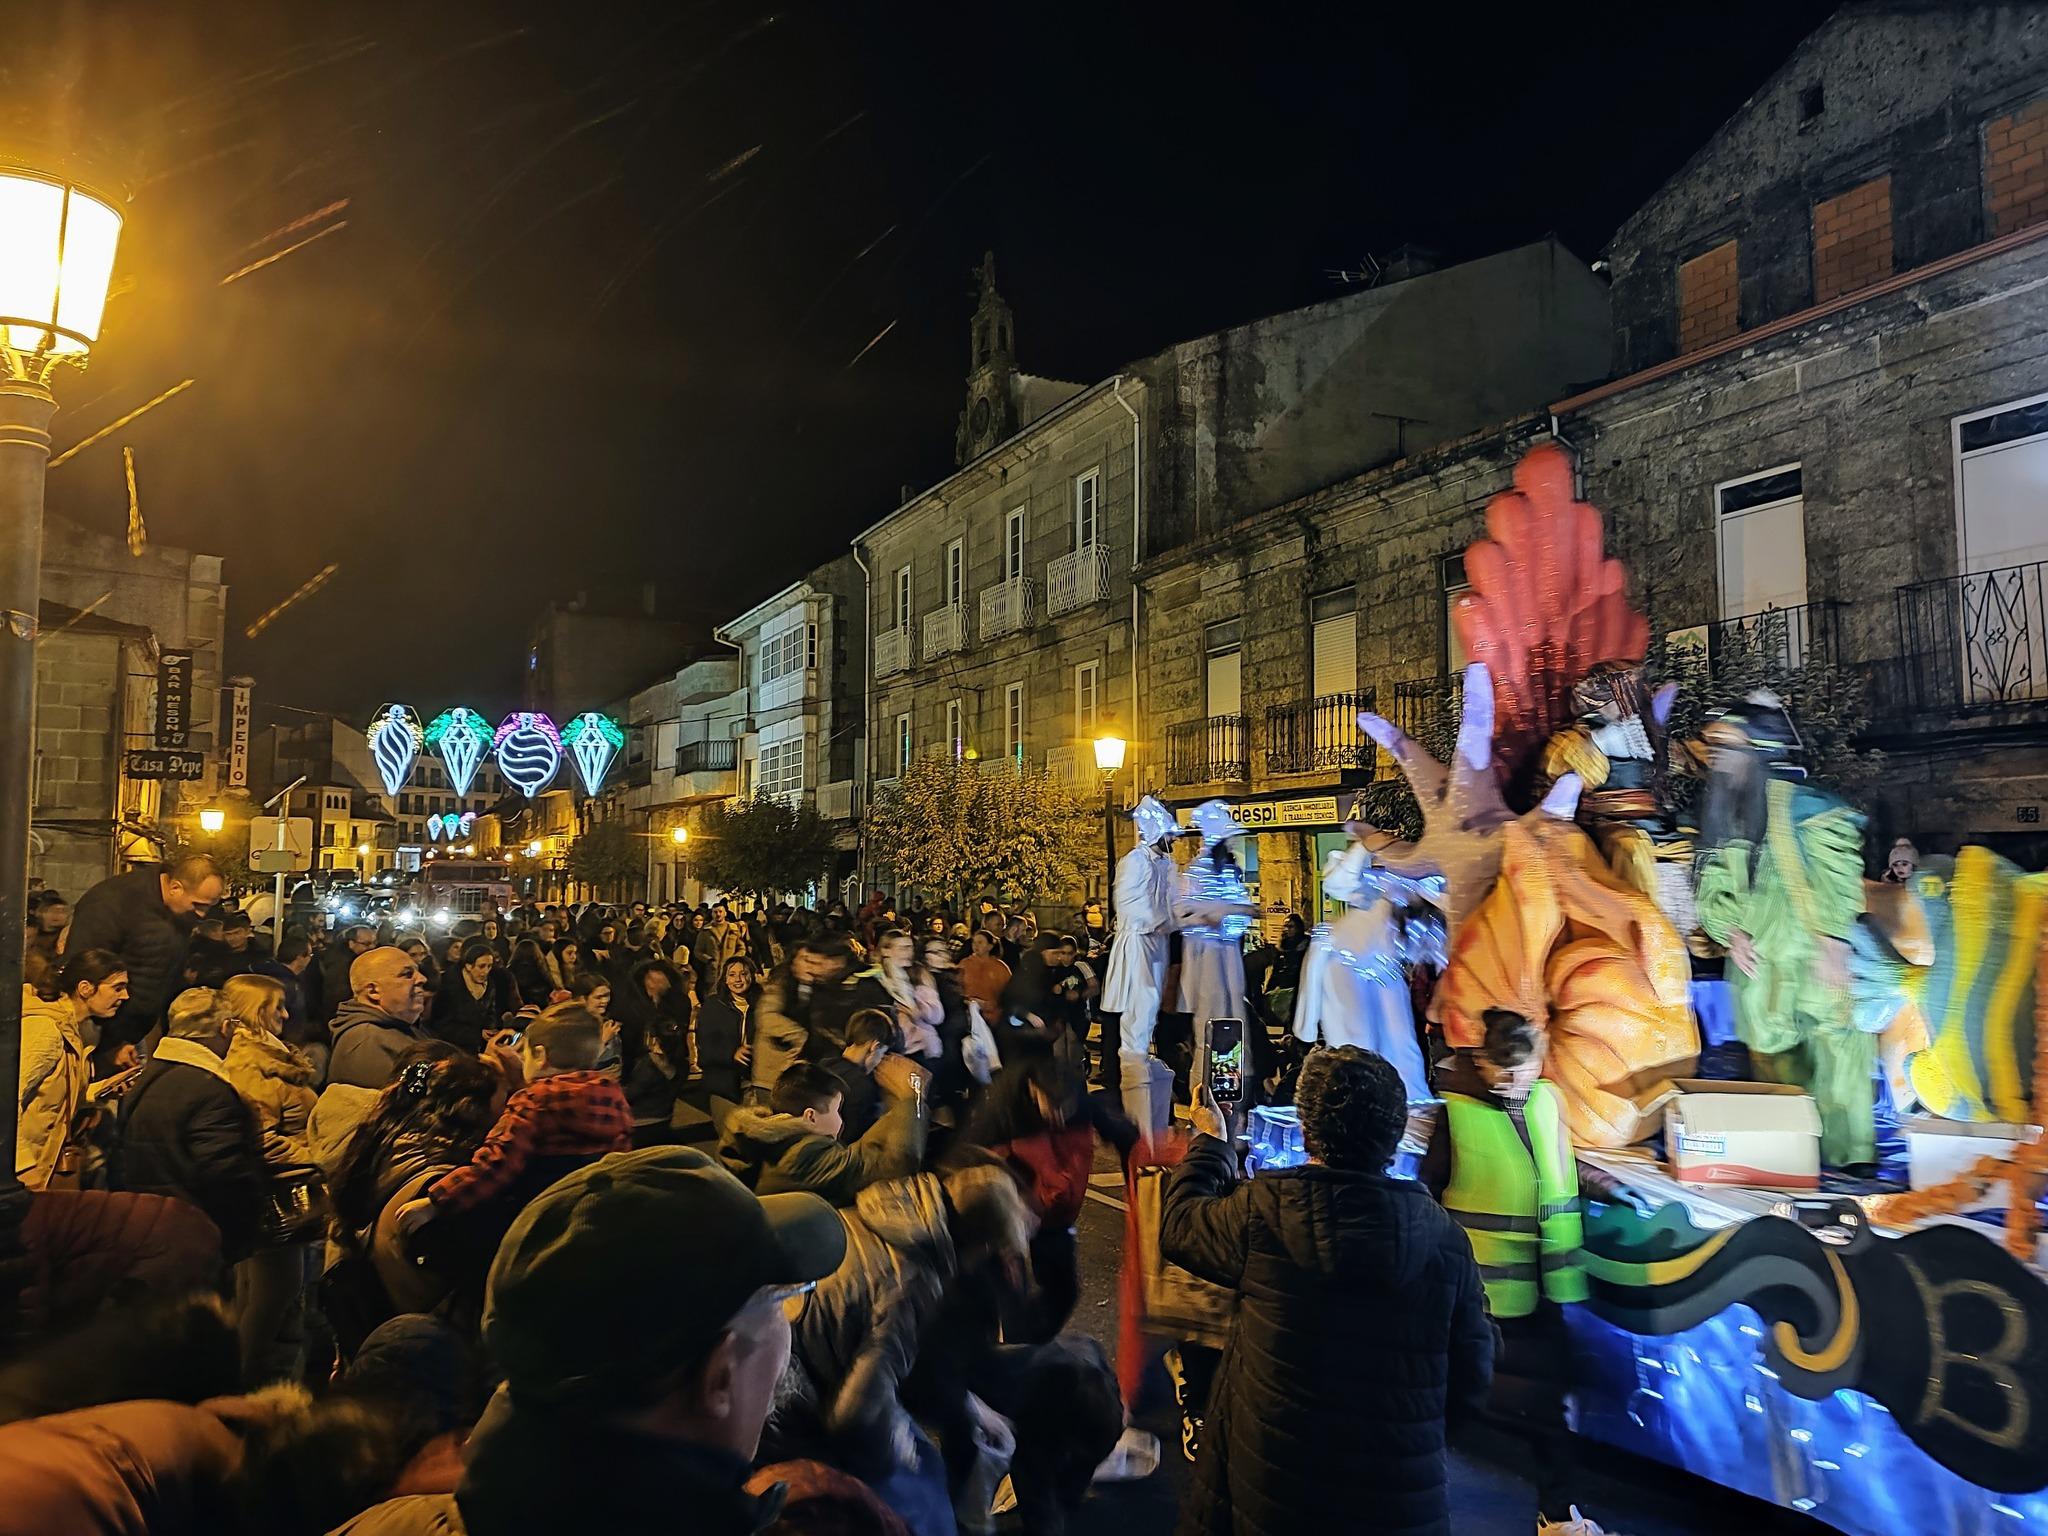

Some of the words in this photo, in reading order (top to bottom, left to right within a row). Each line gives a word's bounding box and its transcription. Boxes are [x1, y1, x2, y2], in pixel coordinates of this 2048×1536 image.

[168, 667, 181, 689] BAR
[166, 695, 181, 731] MESON
[233, 691, 249, 781] IMPERIO
[129, 755, 163, 772] Casa
[168, 755, 202, 777] Pepe
[1227, 802, 1277, 825] despi
